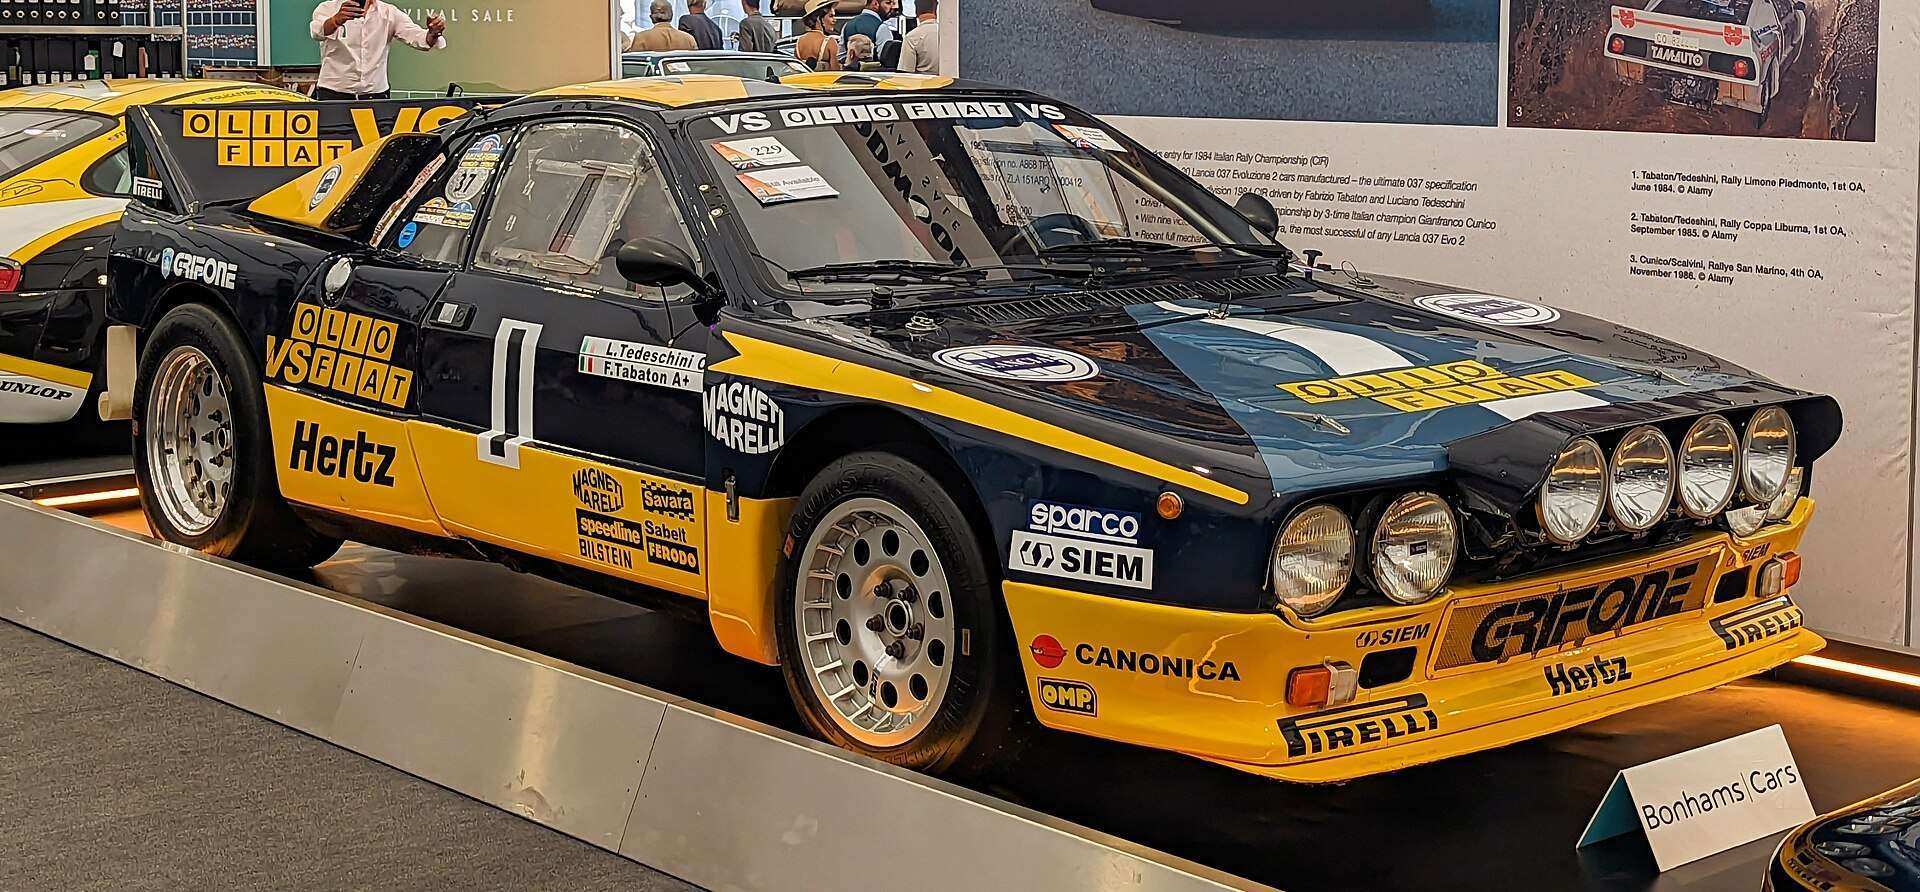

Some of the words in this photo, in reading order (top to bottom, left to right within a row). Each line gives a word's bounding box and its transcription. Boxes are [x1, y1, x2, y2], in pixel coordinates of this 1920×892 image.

[403, 8, 457, 21] VIVAL
[471, 8, 513, 22] SALE
[190, 113, 311, 135] OLIO
[710, 111, 771, 134] VS
[787, 106, 892, 124] OLIO
[911, 103, 1004, 118] FIAT
[1014, 103, 1066, 120] VS
[1515, 106, 1523, 117] 3
[227, 145, 344, 164] FIAT
[750, 145, 783, 156] 229
[1164, 151, 1181, 162] entry
[1182, 150, 1193, 160] for
[1195, 151, 1213, 161] 1984
[1213, 151, 1234, 162] Italian
[1236, 152, 1254, 165] Rally
[1254, 153, 1309, 167] Championship
[133, 176, 163, 200] PIRELLI
[1060, 176, 1083, 187] 00412
[1191, 167, 1215, 177] Lancia
[1216, 168, 1231, 178] 037
[1232, 169, 1271, 181] Evoluzione
[1271, 171, 1278, 181] 2
[1279, 173, 1296, 182] cars
[1297, 173, 1351, 185] manufactured
[1358, 176, 1372, 186] the
[1373, 176, 1406, 188] ultimate
[1407, 178, 1424, 189] 037
[1425, 179, 1478, 191] specification
[1631, 170, 1640, 179] 1.
[1641, 170, 1719, 184] Tabaton/Tedeshini,
[1721, 175, 1743, 187] Rally
[1744, 176, 1776, 187] Limone
[1778, 178, 1830, 191] Piedmonte,
[1832, 181, 1847, 192] 1st
[1848, 181, 1866, 193] OA,
[1631, 182, 1652, 192] June
[1653, 184, 1676, 193] 1984.
[1687, 185, 1714, 197] Alamy
[1268, 188, 1292, 199] driven
[1293, 189, 1304, 202] by
[1305, 190, 1335, 202] Fabrizio
[1337, 191, 1368, 203] Tabaton
[1369, 194, 1385, 205] and
[1387, 195, 1419, 207] Luciano
[1421, 196, 1466, 209] Tedeschini
[1141, 213, 1156, 224] With
[1157, 215, 1172, 225] nine
[1313, 208, 1323, 220] by
[1324, 208, 1350, 220] 3-time
[1351, 210, 1375, 221] Italian
[1376, 212, 1416, 225] champion
[1418, 214, 1464, 228] Gianfranco
[1466, 217, 1497, 230] Cunico
[1630, 212, 1639, 221] 2.
[1640, 213, 1718, 228] Tabaton/Tedeshini,
[1720, 218, 1742, 231] Rally
[1743, 220, 1773, 232] Coppa
[1813, 225, 1828, 235] 1st
[1829, 225, 1847, 237] OA,
[1141, 229, 1164, 241] Recent
[1165, 231, 1175, 241] full
[1289, 224, 1302, 234] the
[1303, 225, 1324, 236] most
[1325, 227, 1366, 239] successful
[1367, 229, 1377, 240] of
[1377, 231, 1392, 242] any
[1393, 231, 1421, 242] Lancia
[1422, 232, 1440, 244] 037
[1441, 234, 1457, 246] Evo
[1458, 235, 1466, 246] 2
[1630, 224, 1676, 236] September
[1677, 228, 1700, 238] 1985.
[1711, 230, 1738, 242] Alamy
[173, 251, 238, 290] GRIFONE
[1629, 254, 1639, 264] 3.
[1639, 255, 1706, 270] Cunico/Scalvini,
[1708, 260, 1734, 273] Rallye
[1736, 263, 1753, 273] San
[1755, 265, 1788, 277] Marino,
[1790, 267, 1805, 277] 4th
[1807, 269, 1824, 280] OA,
[1629, 266, 1672, 278] November
[1673, 270, 1696, 280] 1986.
[1707, 273, 1734, 285] Alamy
[298, 309, 391, 356] OLIO
[606, 341, 695, 369] L.Tedeschini
[265, 335, 312, 384] VS
[316, 353, 407, 402] FIAT
[604, 361, 667, 385] F.Tabaton
[671, 372, 690, 387] A+
[0, 380, 73, 400] UNLOP
[1297, 364, 1489, 399] OLIO
[1400, 373, 1577, 408] FIAT
[703, 382, 783, 424] MAGNETI
[703, 416, 785, 454] MARELLI
[289, 420, 397, 488] Hertz
[572, 468, 623, 494] MAGNETI
[573, 488, 624, 513] MARELLI
[644, 490, 692, 511] Savara
[580, 517, 641, 545] speedline
[644, 520, 687, 543] Sabelt
[1030, 502, 1139, 540] sparco
[578, 538, 633, 570] BILSTEIN
[648, 542, 698, 568] FERODO
[1061, 546, 1144, 582] SIEM
[1742, 542, 1771, 561] SIEM
[1471, 562, 1700, 663] GRIFONE
[1708, 594, 1804, 651] PIRELLI
[1379, 623, 1431, 646] SIEM
[1075, 643, 1241, 682] CANONICA
[1543, 655, 1632, 697] Hertz
[1276, 692, 1438, 758] PIRELLI
